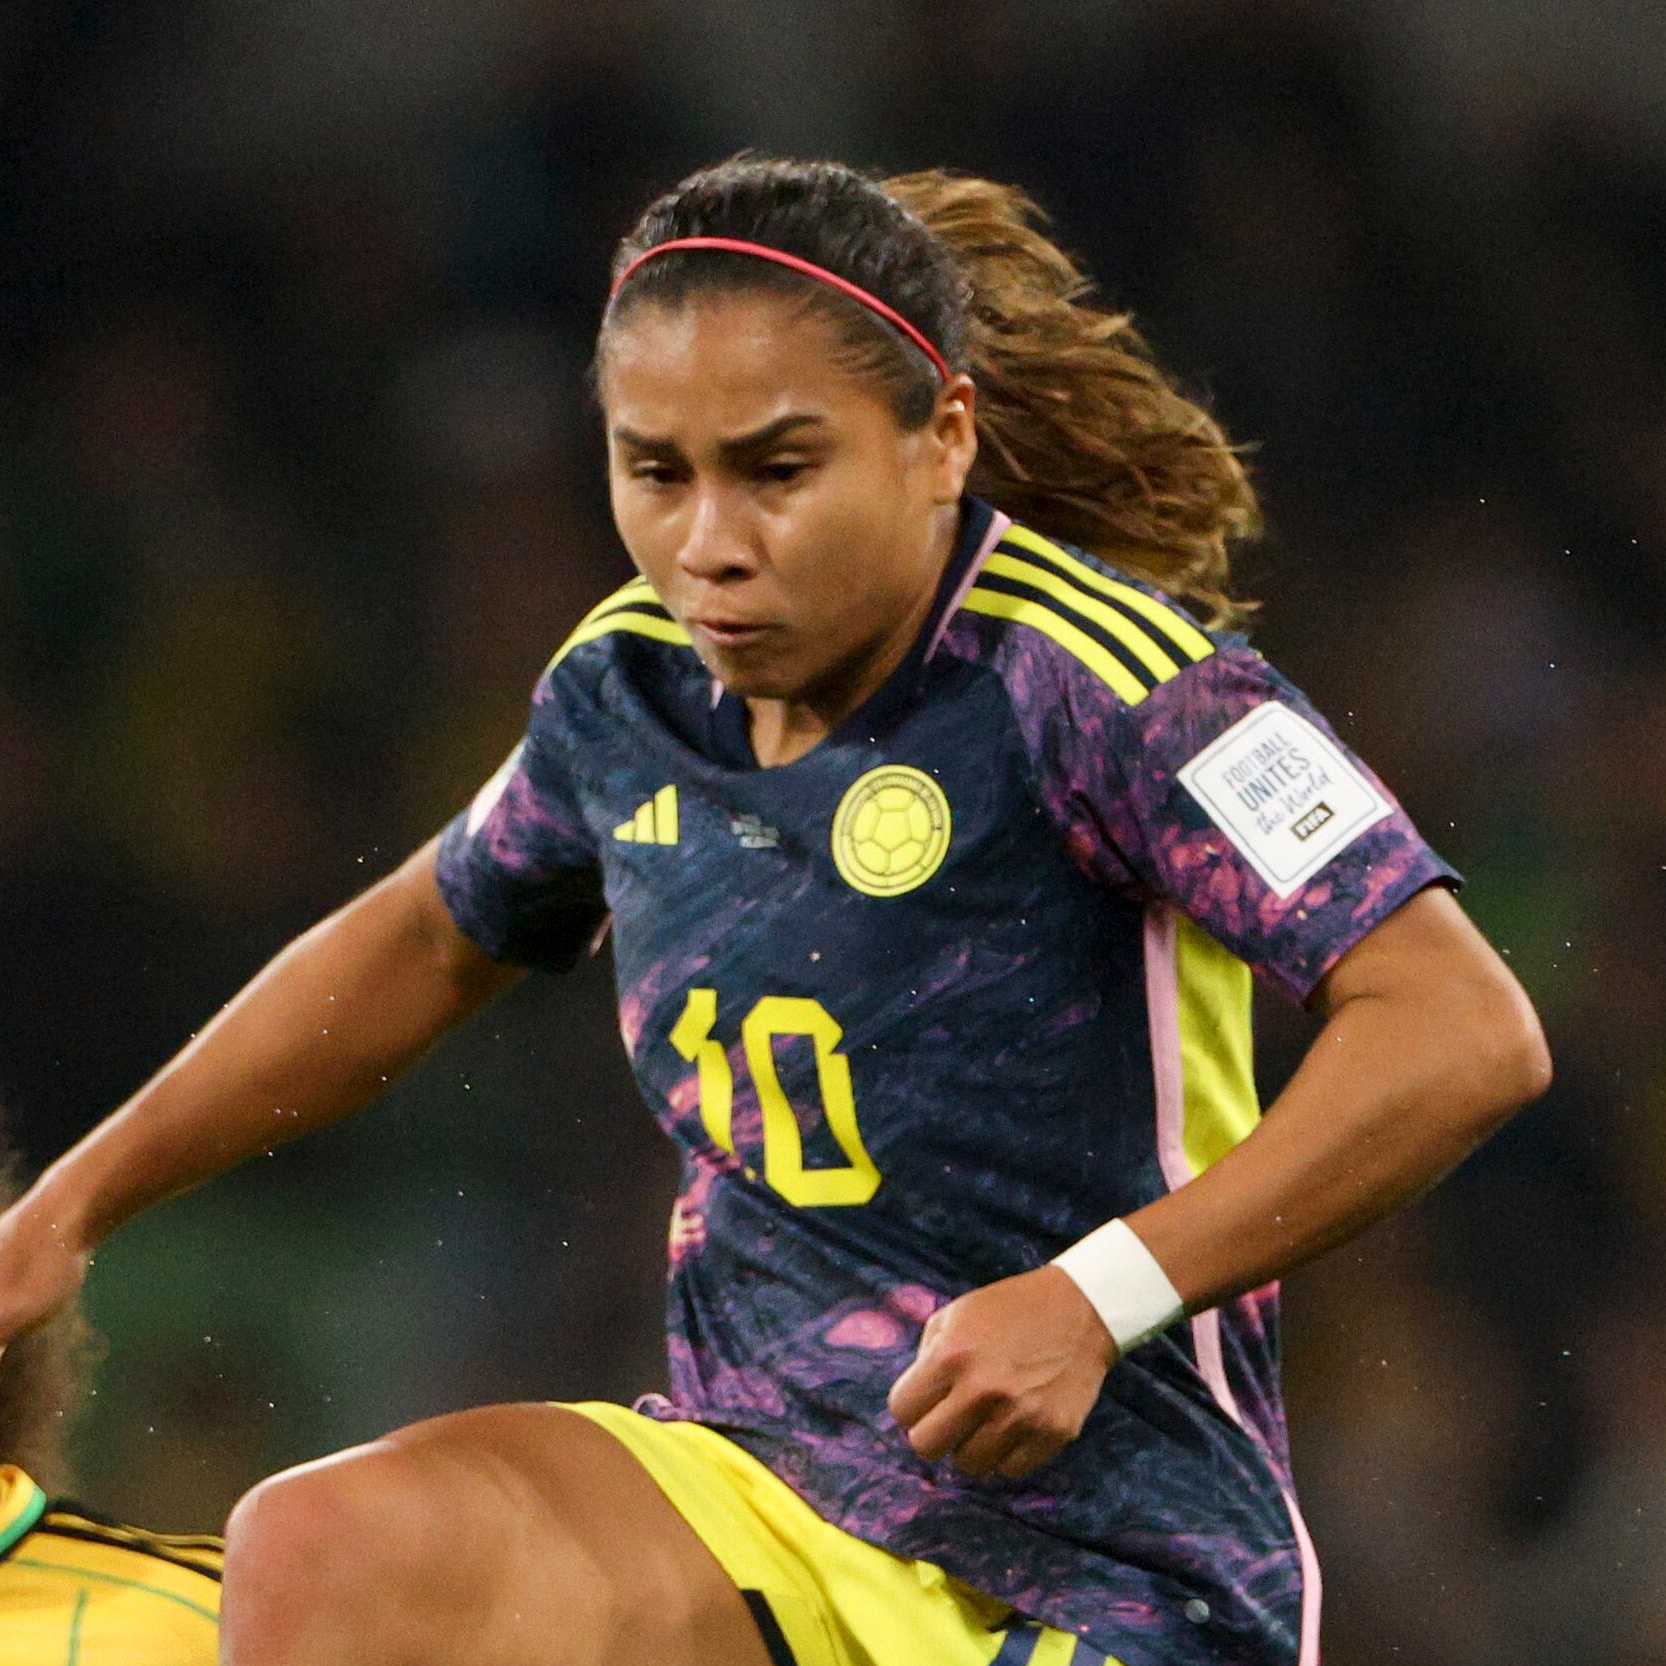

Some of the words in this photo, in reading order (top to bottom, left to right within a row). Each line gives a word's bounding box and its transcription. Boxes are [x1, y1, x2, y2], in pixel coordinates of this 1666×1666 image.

[1222, 732, 1290, 789] FOOTBALL
[1237, 747, 1310, 811] UNITES
[1256, 811, 1285, 835] the
[1278, 765, 1333, 814] World
[1293, 804, 1332, 839] FIFA
[669, 987, 882, 1207] 10
